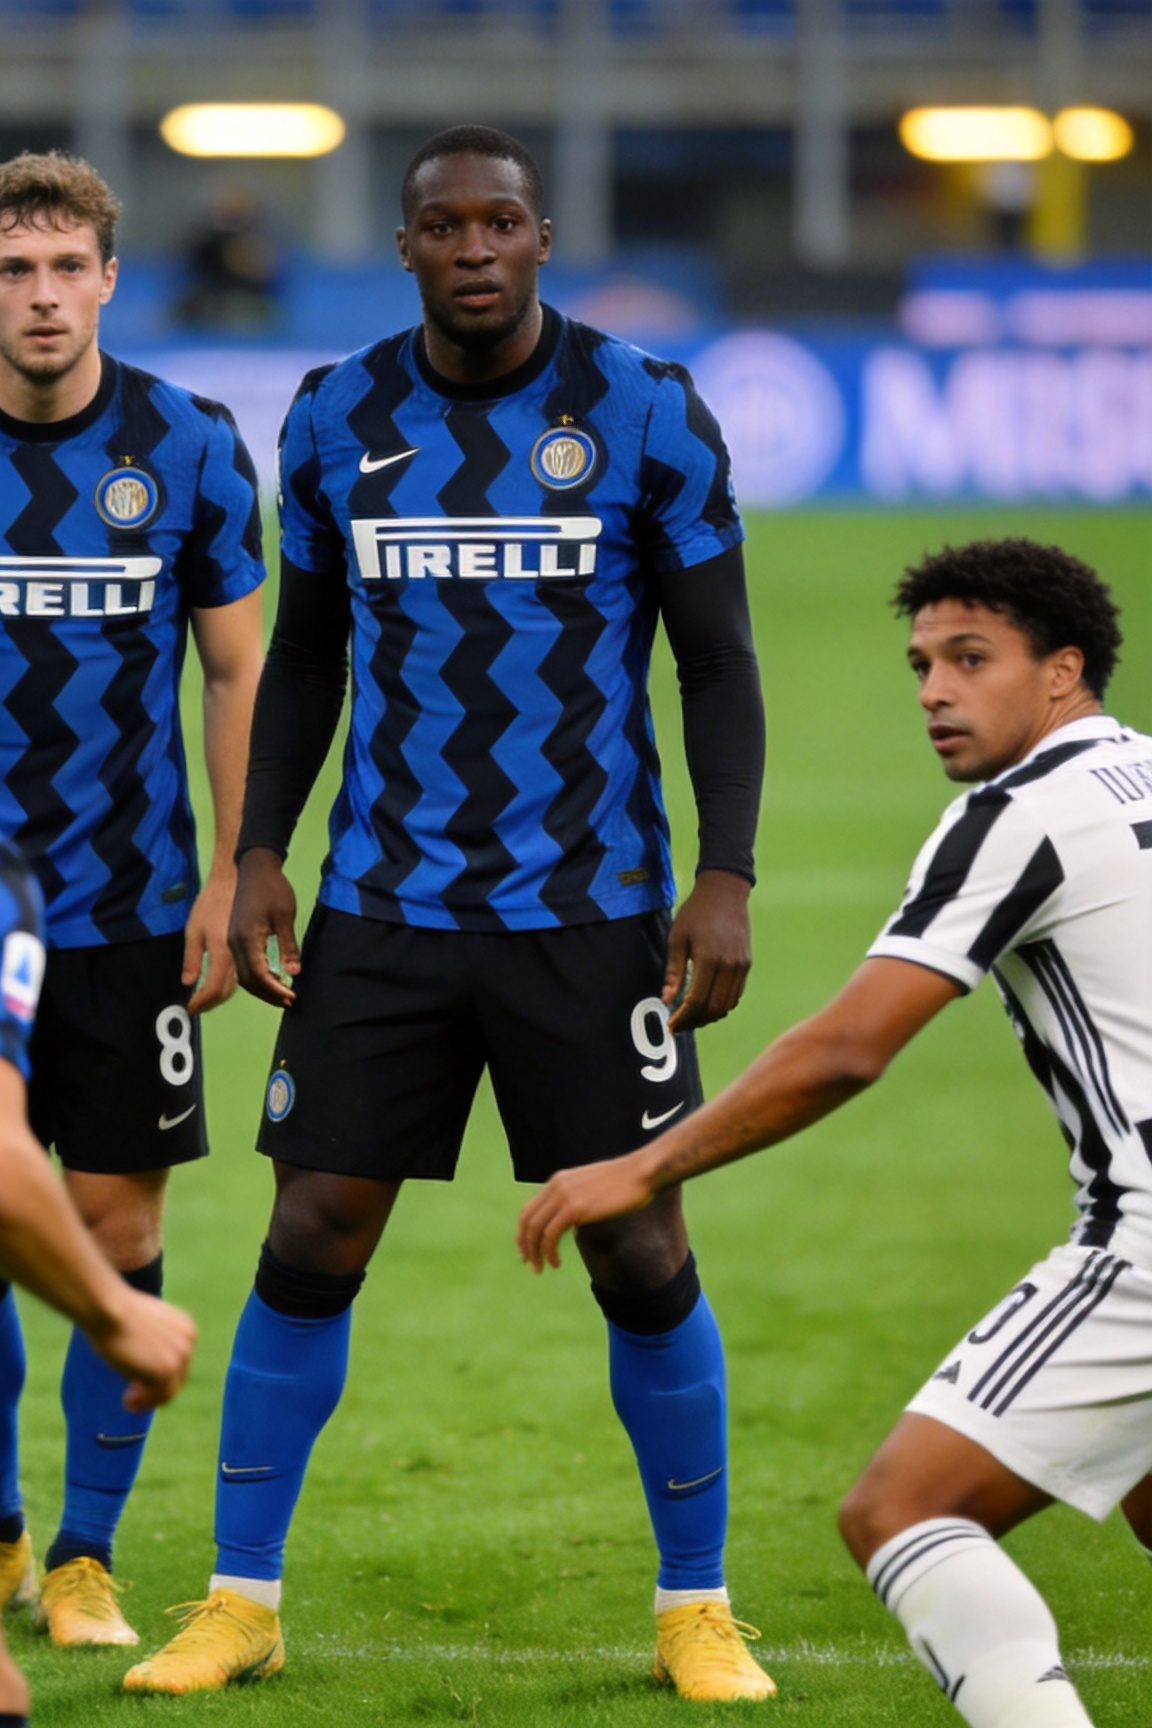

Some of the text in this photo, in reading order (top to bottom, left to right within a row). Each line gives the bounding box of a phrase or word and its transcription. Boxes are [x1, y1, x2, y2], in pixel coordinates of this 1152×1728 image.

[350, 517, 603, 579] PIRELLI
[155, 1004, 194, 1086] 8
[630, 996, 678, 1082] 9
